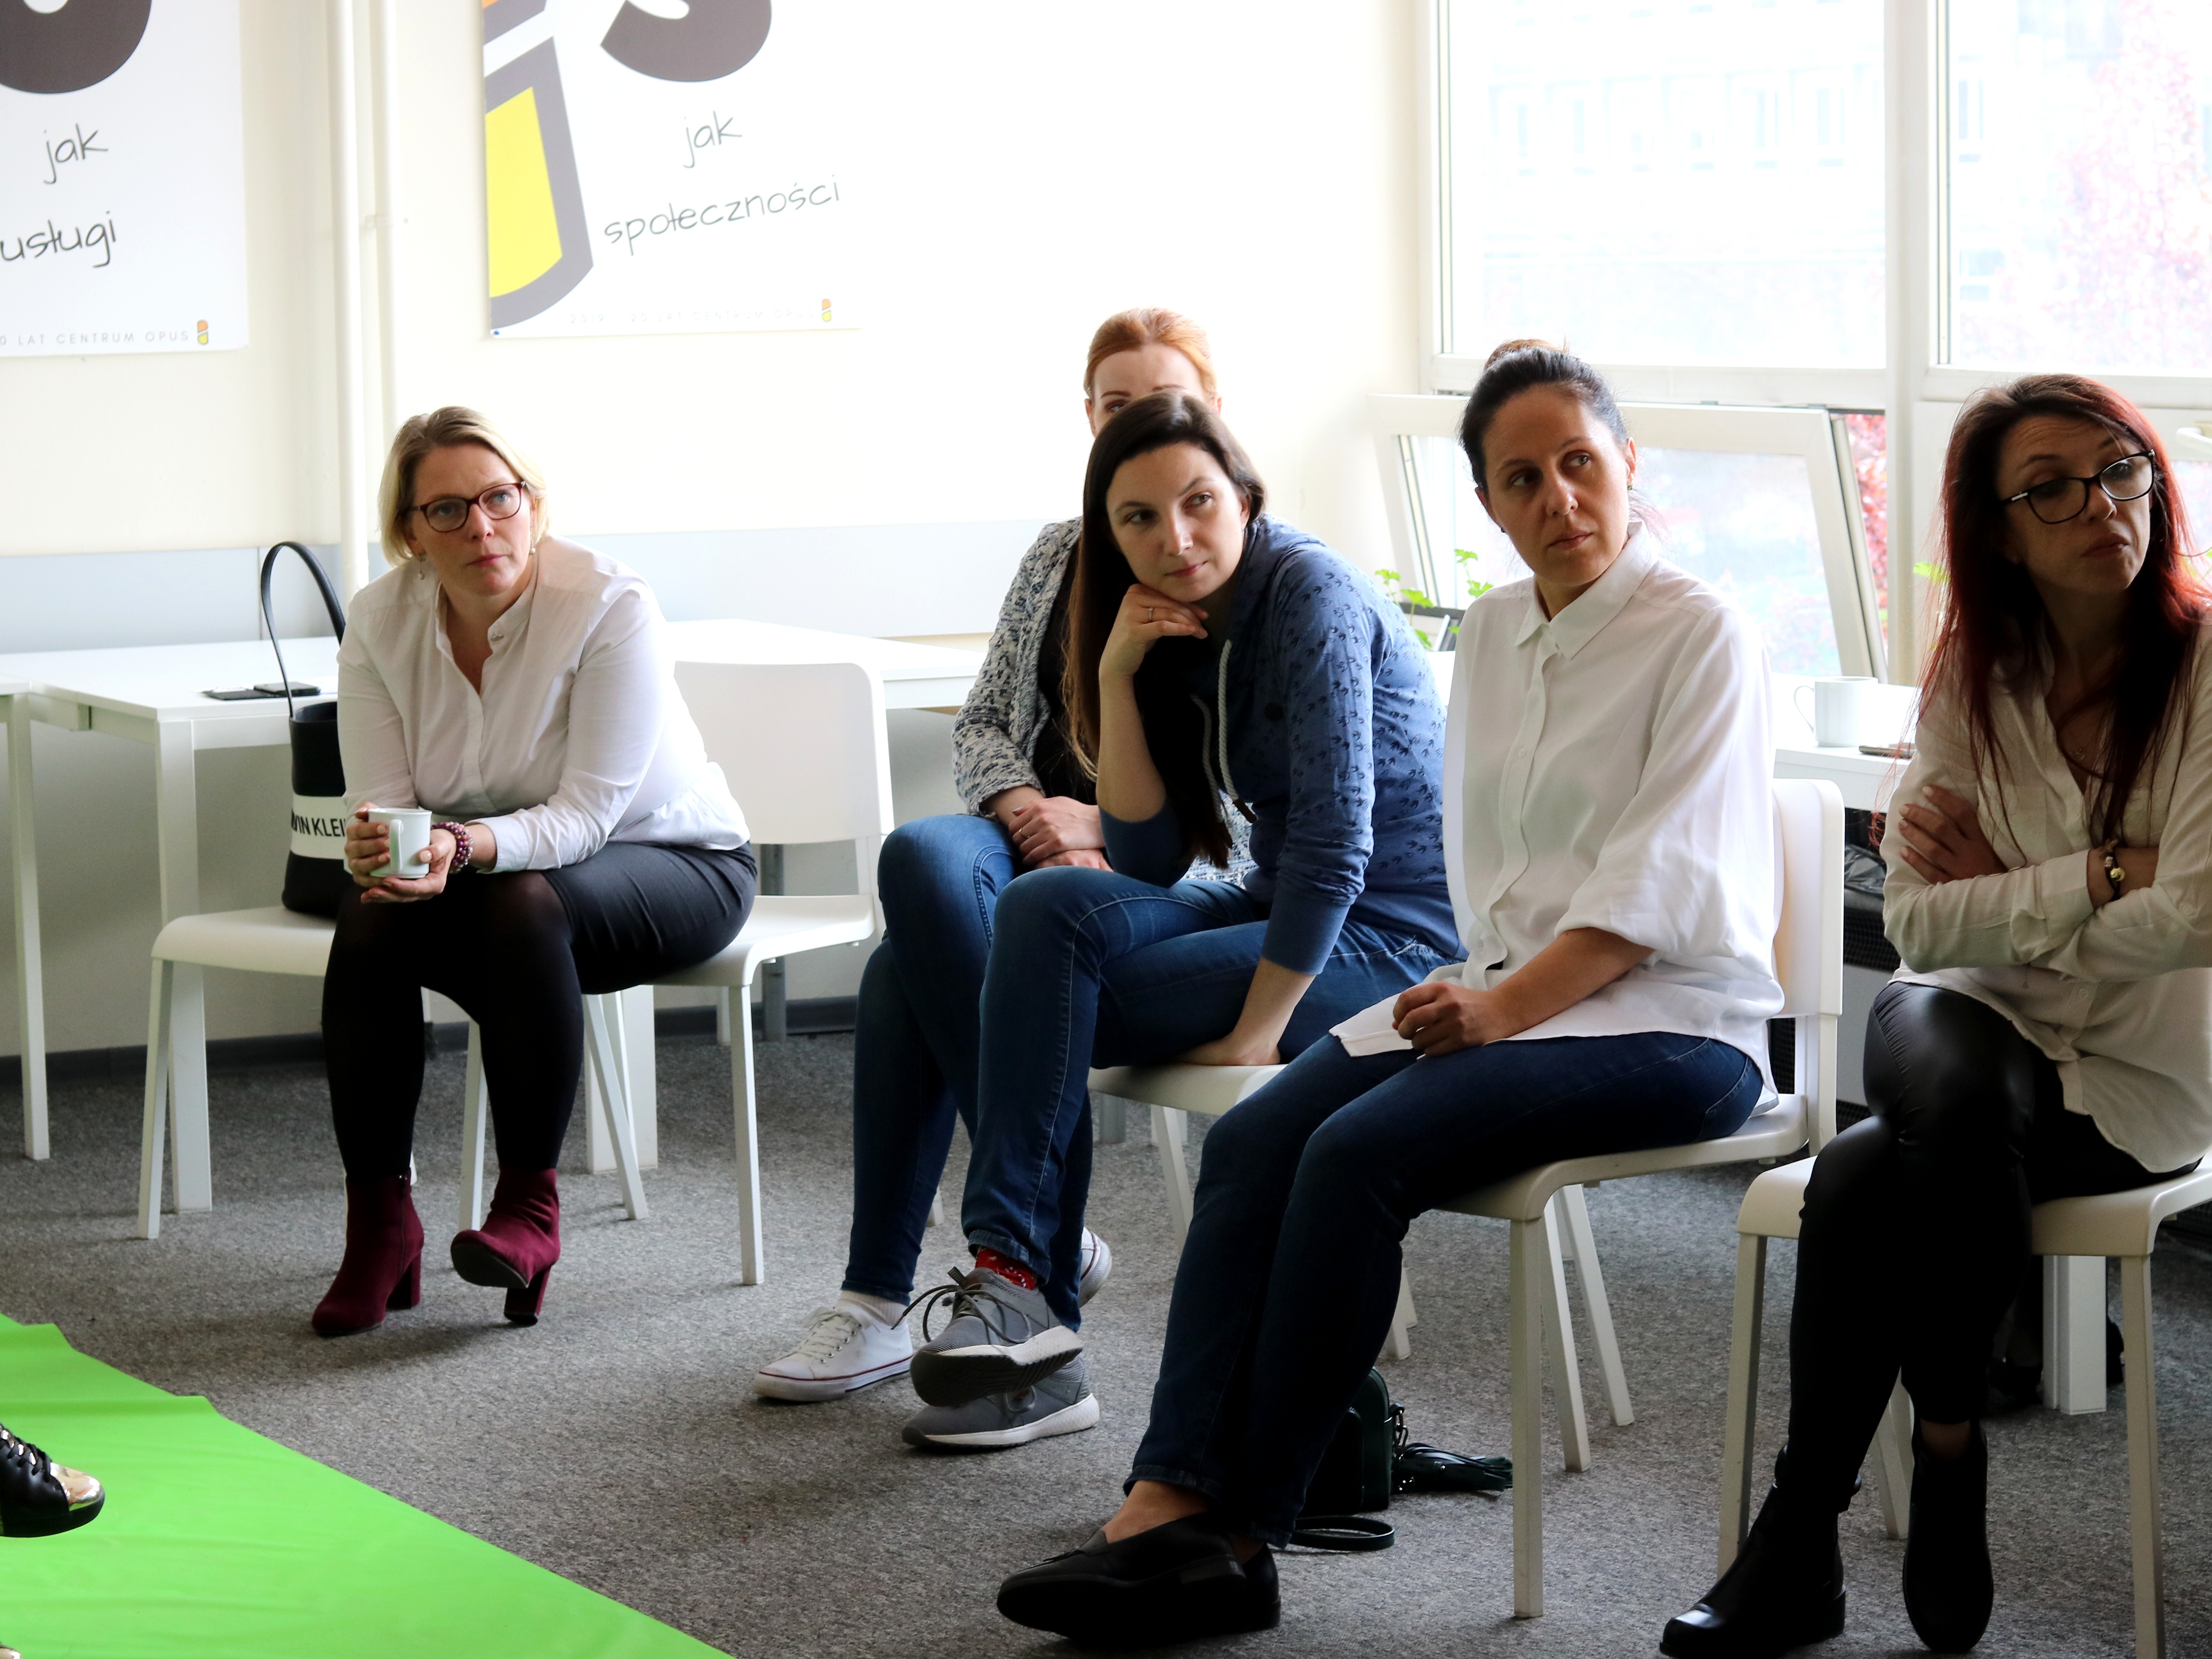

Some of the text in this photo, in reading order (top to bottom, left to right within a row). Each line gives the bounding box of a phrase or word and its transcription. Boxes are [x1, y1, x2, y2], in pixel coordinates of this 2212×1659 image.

[43, 123, 109, 185] jak
[683, 110, 743, 169] jak
[0, 210, 116, 269] usługi
[604, 173, 840, 257] społeczności
[17, 334, 45, 345] LAT
[56, 333, 134, 344] CENTRUM
[145, 330, 188, 342] OPUS
[570, 313, 604, 324] 2019
[630, 312, 647, 323] 20
[658, 311, 682, 322] LAT
[693, 309, 763, 321] CENTRUM
[773, 309, 813, 319] OPUS
[311, 817, 346, 837] KLEI
